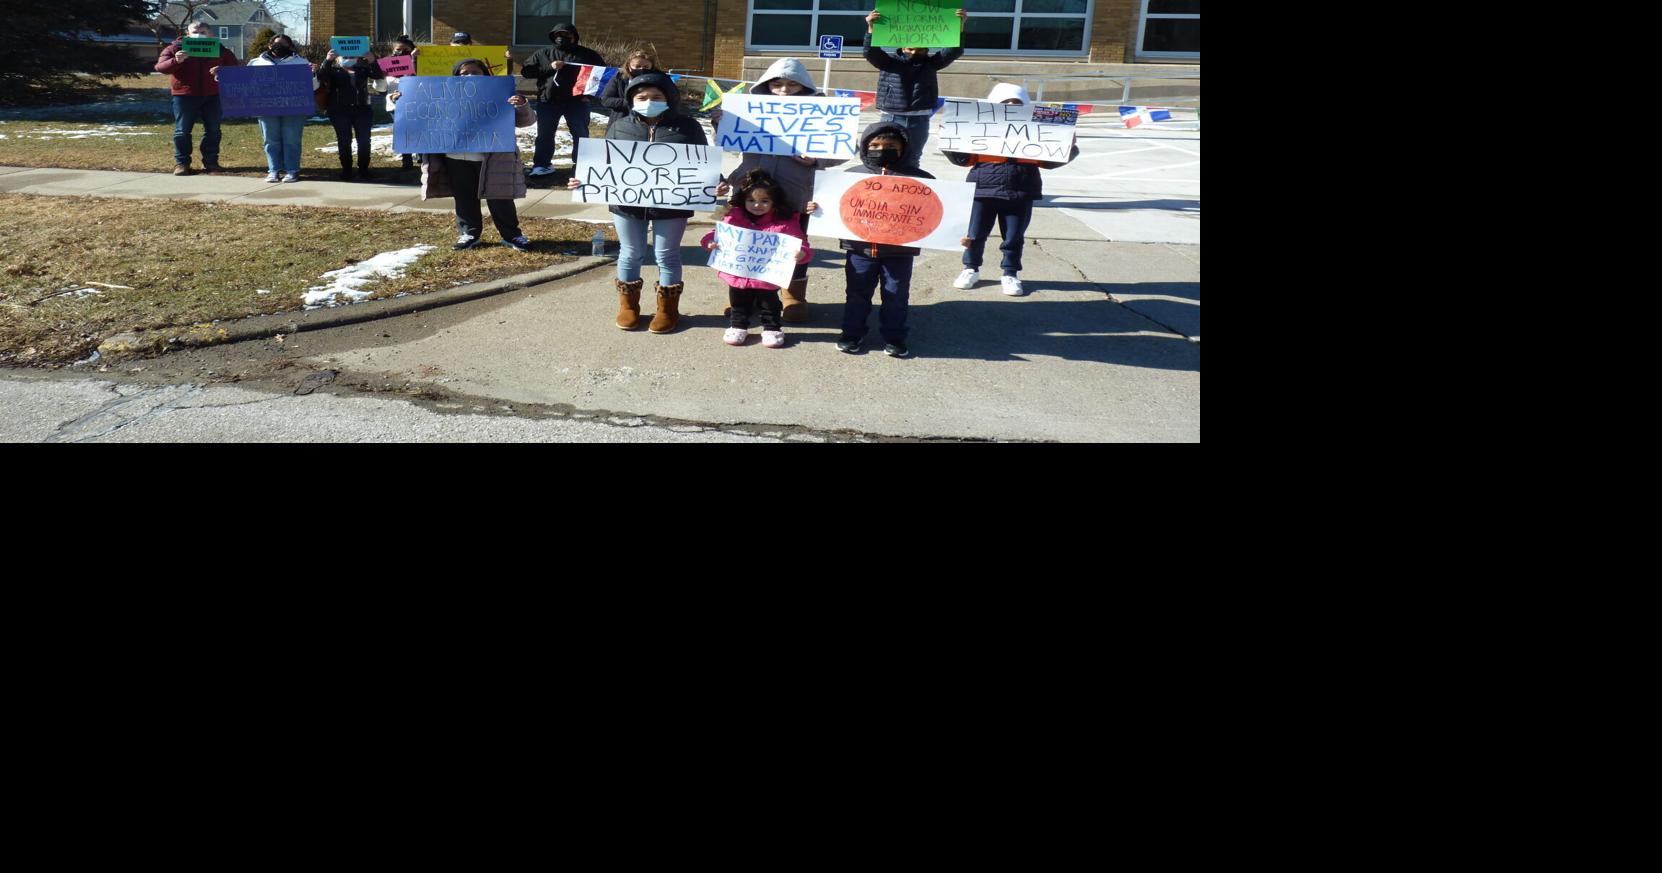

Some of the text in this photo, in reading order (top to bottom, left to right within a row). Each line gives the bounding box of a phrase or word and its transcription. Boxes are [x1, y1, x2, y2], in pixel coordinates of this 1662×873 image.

[887, 33, 940, 45] AHORA
[405, 101, 499, 121] ECONOMICO
[747, 101, 861, 117] HISPANIC
[945, 100, 1027, 122] THE
[733, 116, 846, 133] LIVES
[945, 121, 1061, 143] TIME
[721, 132, 857, 156] MATTER
[937, 138, 1072, 158] IS NOW
[587, 166, 705, 186] MORE
[577, 183, 718, 206] PROMISES
[865, 181, 932, 196] YO APOYO
[850, 198, 923, 216] UN DIA SIN
[853, 208, 926, 227] INMIGRANTES
[718, 223, 744, 243] MY
